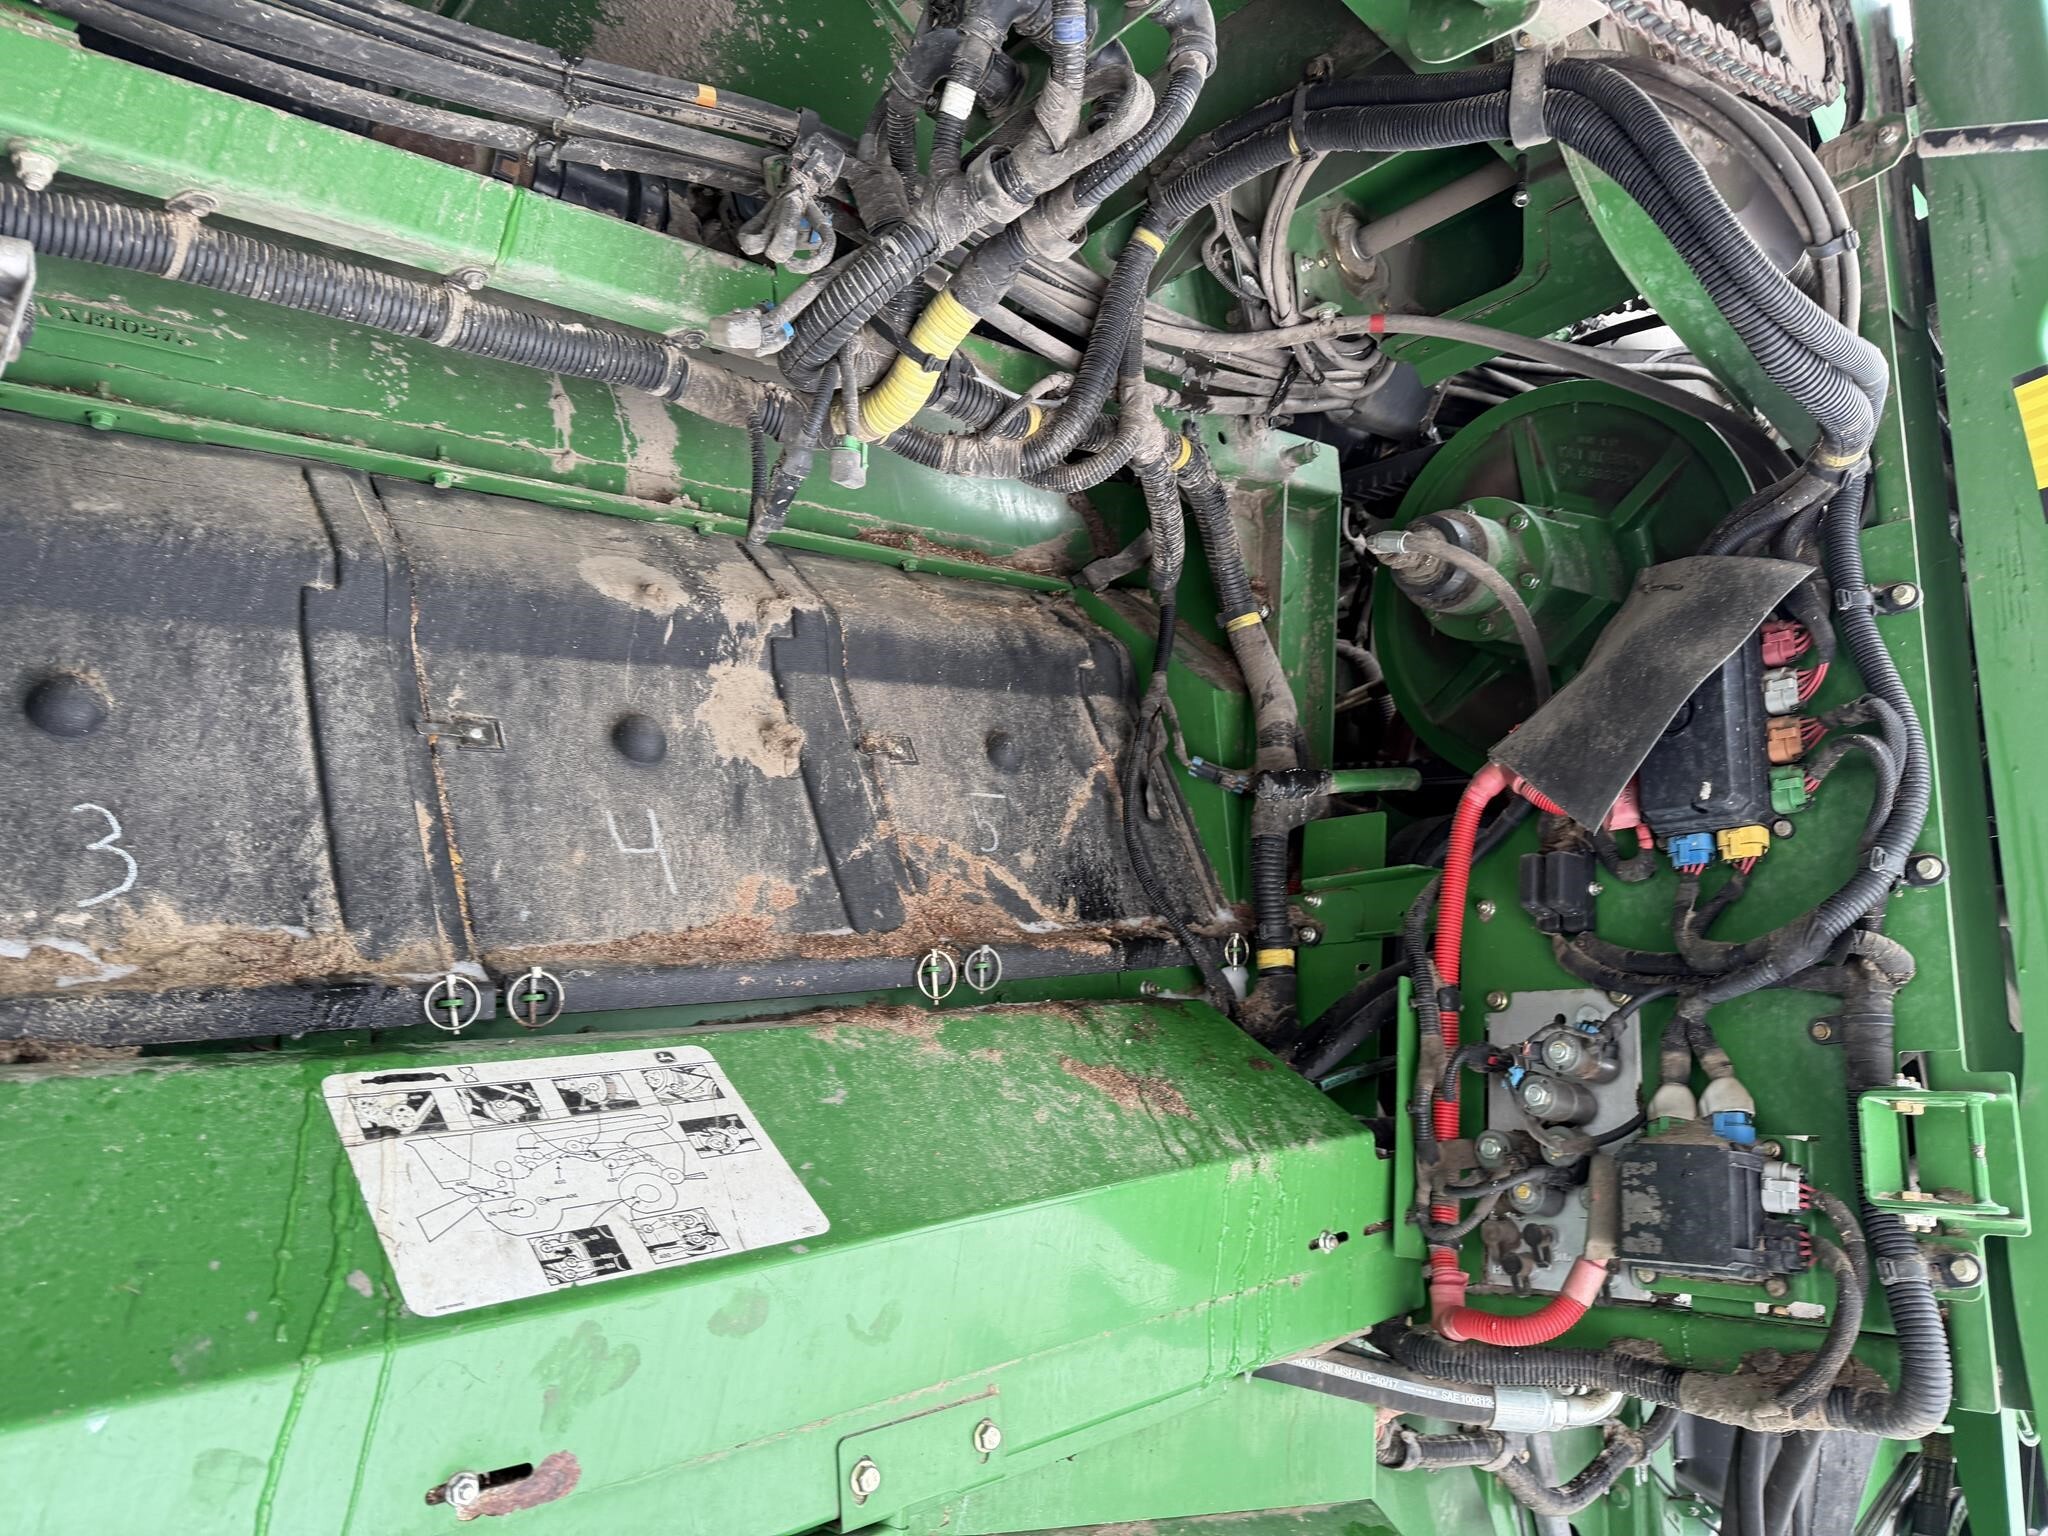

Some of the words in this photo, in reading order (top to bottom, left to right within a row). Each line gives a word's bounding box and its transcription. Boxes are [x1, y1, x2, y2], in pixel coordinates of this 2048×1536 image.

[71, 803, 138, 907] 3
[605, 808, 678, 896] 4
[966, 792, 1006, 852] 5
[1334, 1363, 1361, 1380] MSHA
[1441, 1390, 1460, 1401] SAE
